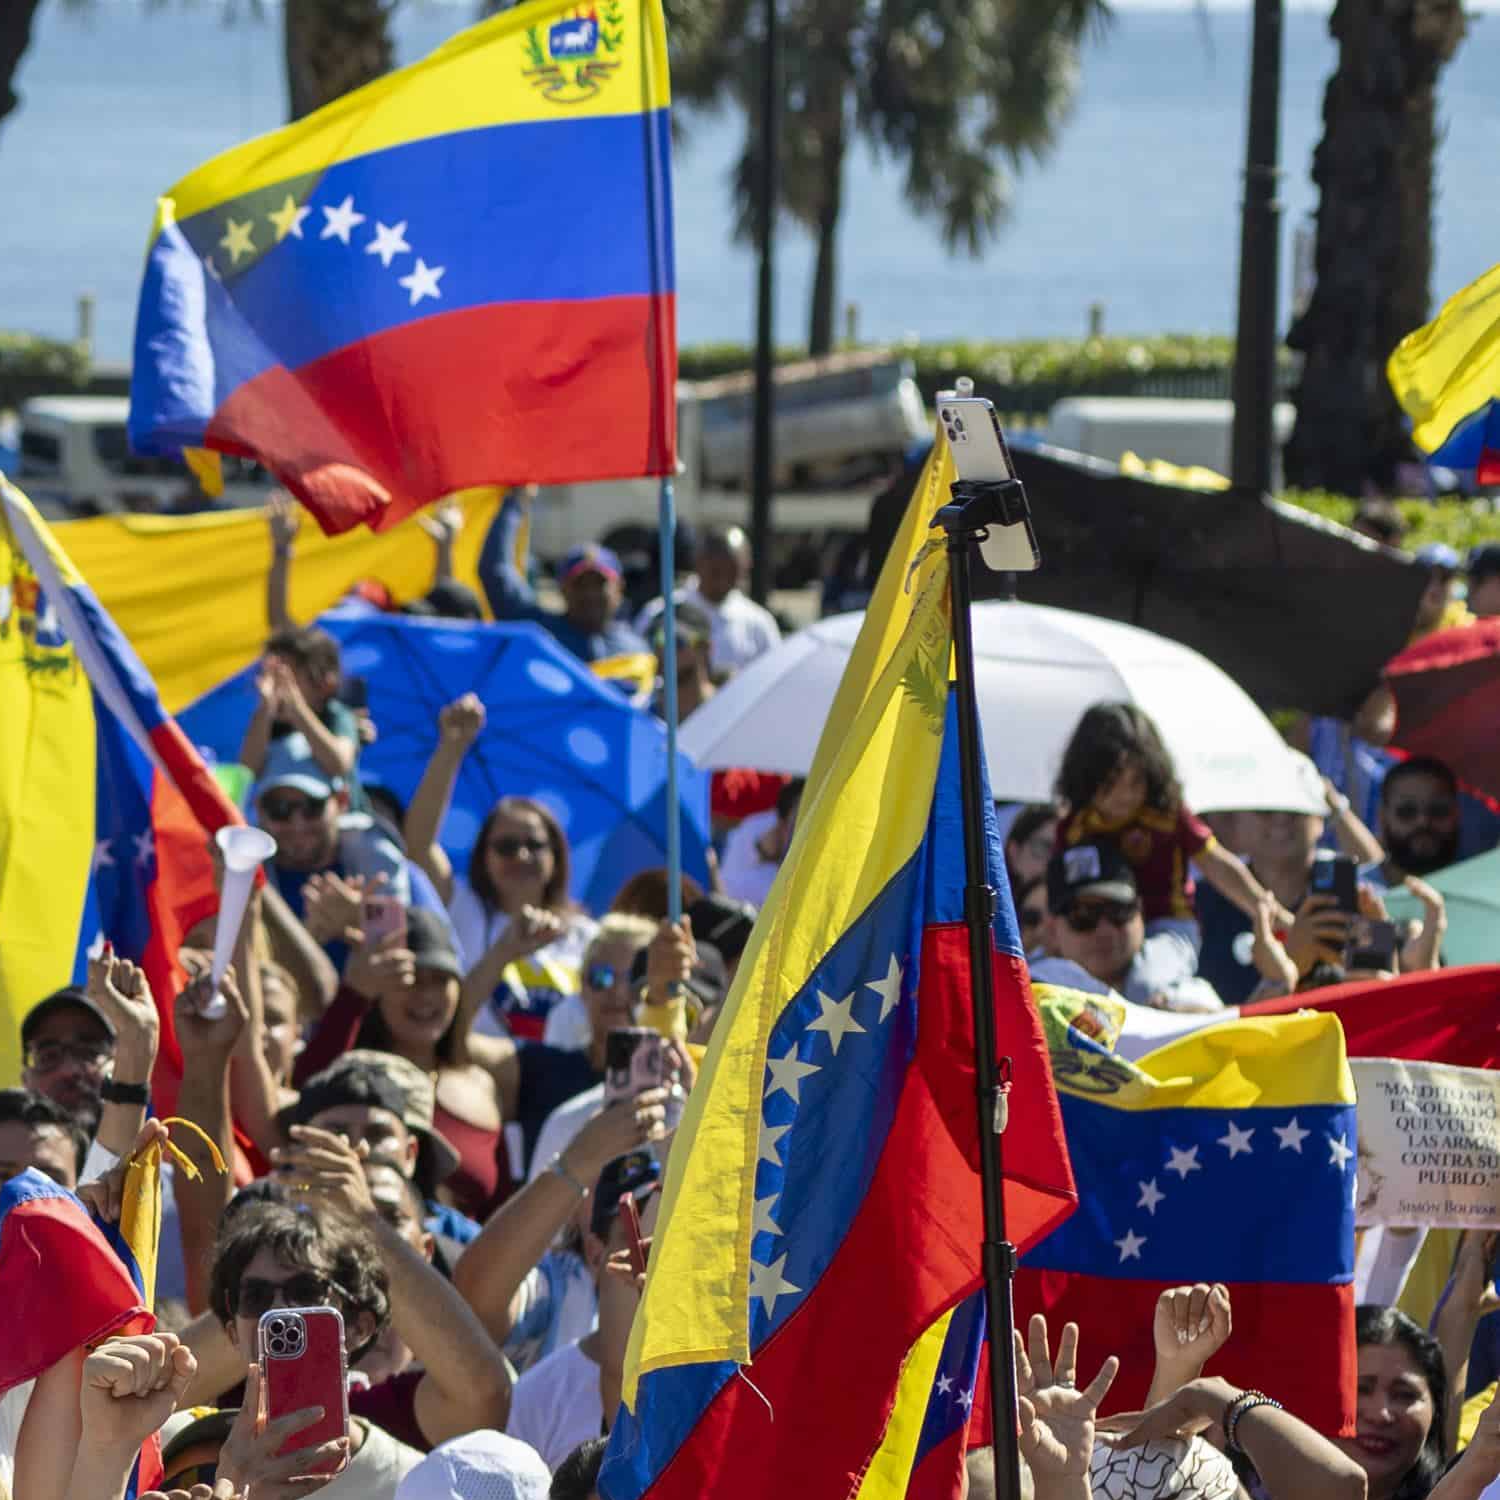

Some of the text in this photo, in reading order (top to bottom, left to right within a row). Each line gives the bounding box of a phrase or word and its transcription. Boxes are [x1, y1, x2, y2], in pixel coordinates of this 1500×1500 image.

[1408, 1135, 1439, 1149] LAS
[1401, 1152, 1500, 1169] CONTRA SU
